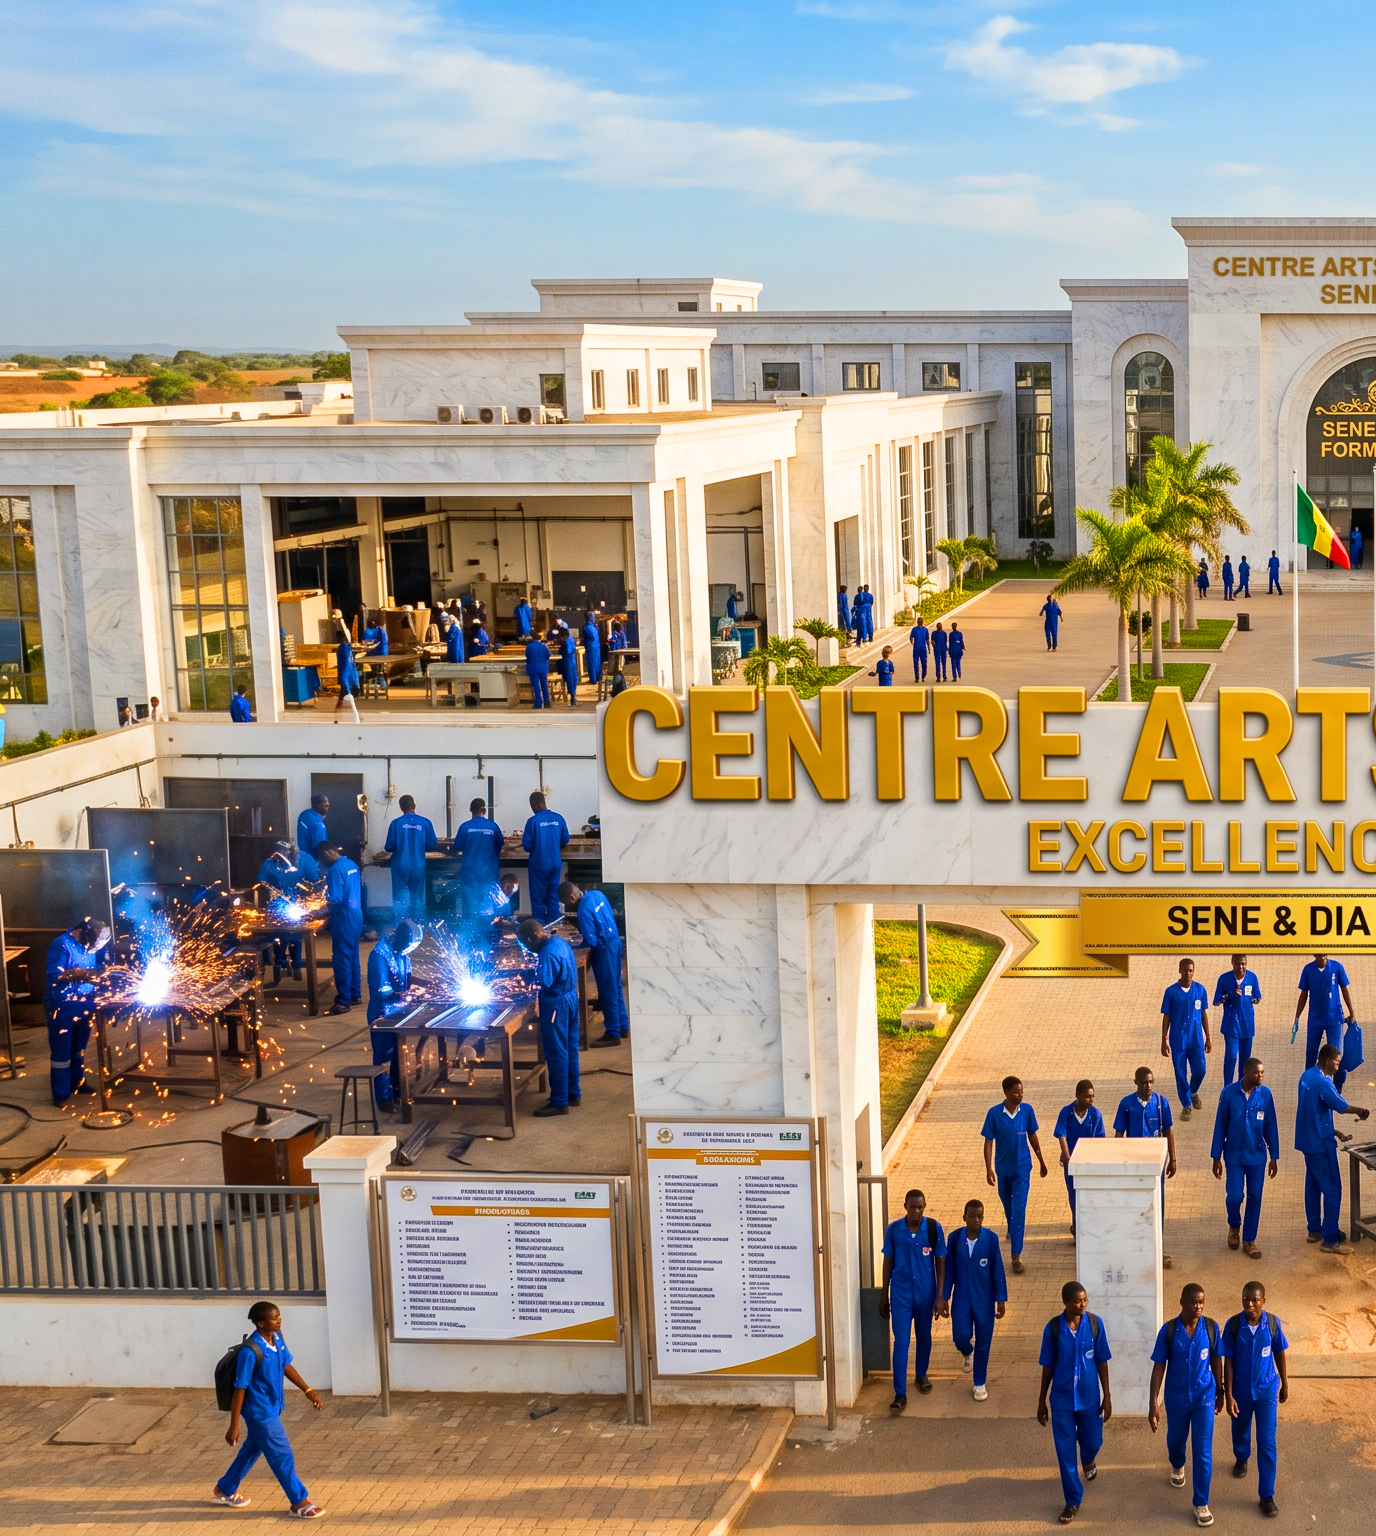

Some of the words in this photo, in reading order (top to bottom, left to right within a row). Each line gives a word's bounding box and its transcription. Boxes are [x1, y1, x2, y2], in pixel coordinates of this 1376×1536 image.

[1213, 257, 1315, 277] CENTRE
[1322, 421, 1376, 438] SENE
[602, 686, 1089, 802] CENTRE
[1167, 905, 1261, 936] SENE
[1273, 905, 1297, 936] &
[1310, 906, 1371, 936] DIA
